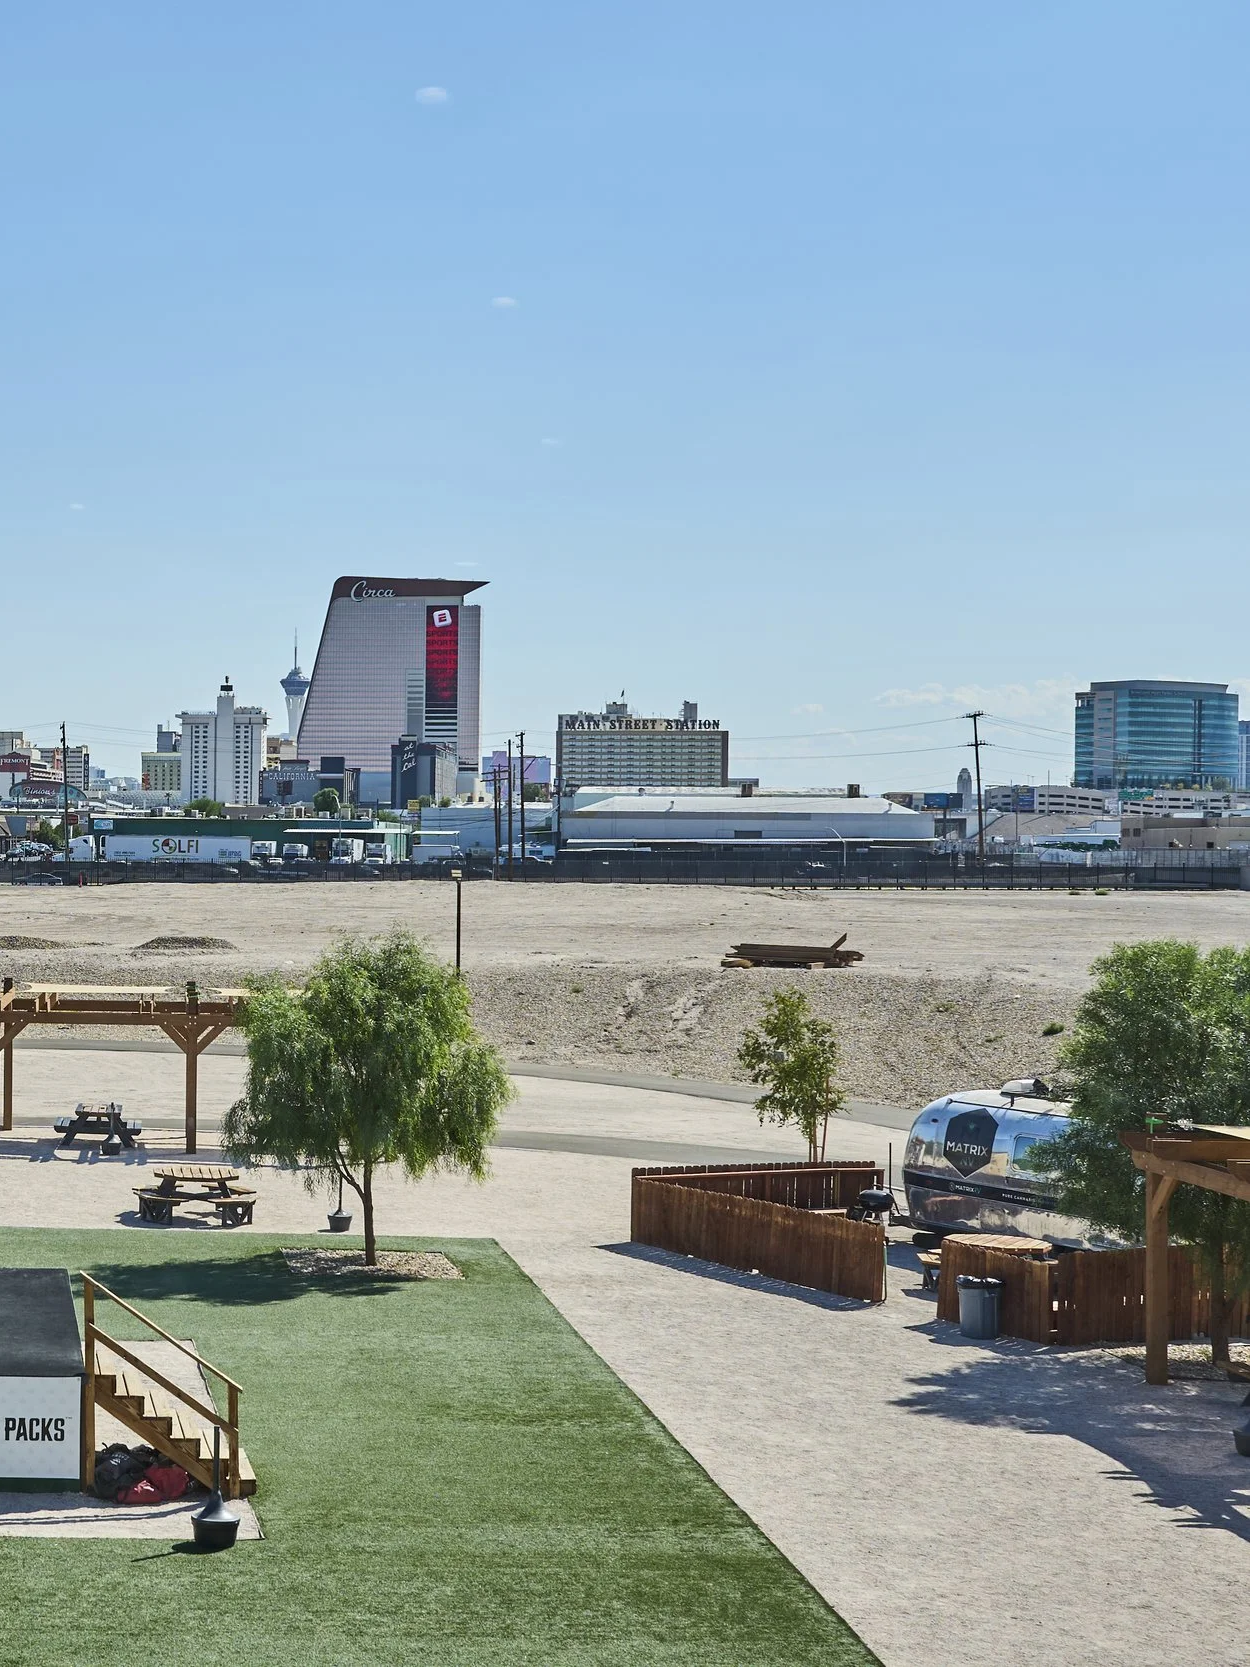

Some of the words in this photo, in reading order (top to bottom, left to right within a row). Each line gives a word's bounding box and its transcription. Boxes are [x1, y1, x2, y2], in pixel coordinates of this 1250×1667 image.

[350, 580, 396, 602] Circa
[565, 719, 600, 730] MAIN
[610, 719, 656, 730] STREET
[665, 719, 720, 730] STATION
[404, 742, 414, 751] at
[0, 758, 29, 766] FREMONT
[402, 752, 415, 761] the
[401, 758, 417, 773] Cal
[268, 772, 316, 780] CALIFORNIA
[152, 838, 199, 854] SOLFI
[946, 1140, 989, 1157] MATRIX
[4, 1417, 65, 1442] PACKS
